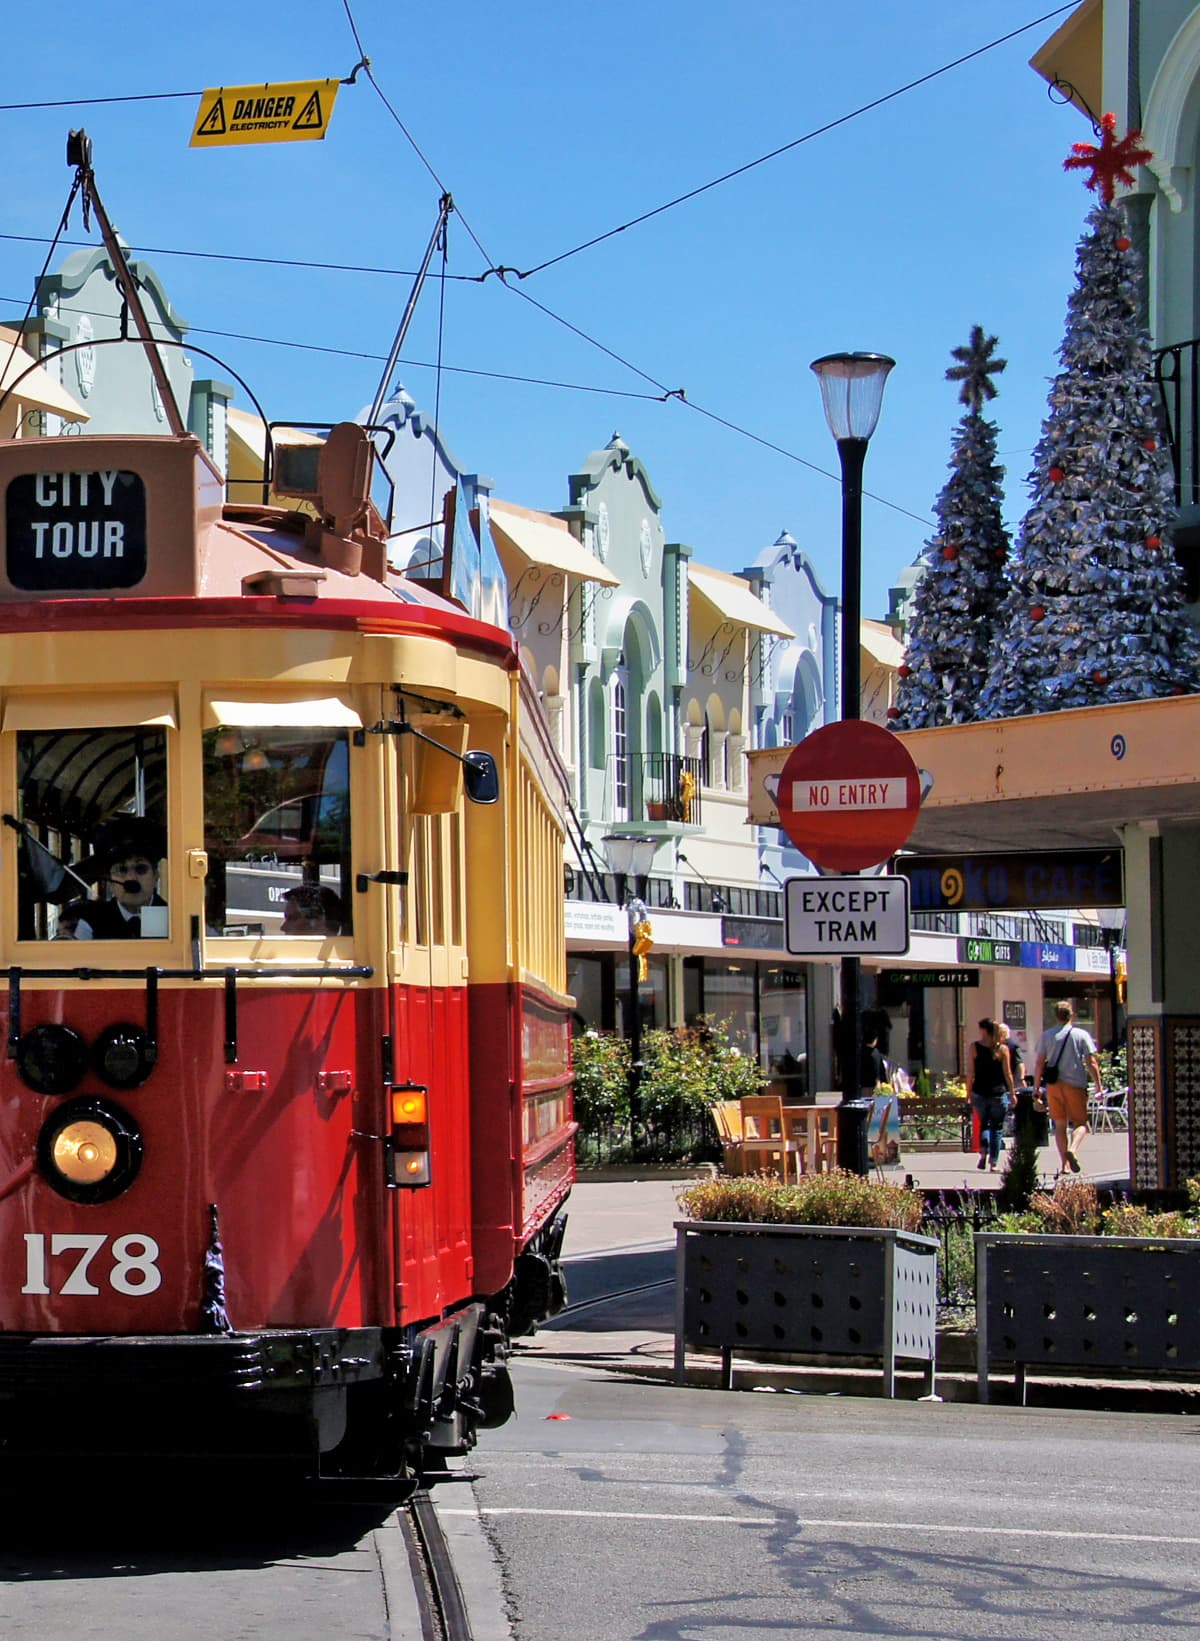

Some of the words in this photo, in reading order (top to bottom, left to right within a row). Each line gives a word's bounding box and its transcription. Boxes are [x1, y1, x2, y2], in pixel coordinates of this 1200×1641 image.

[232, 96, 296, 120] DANGER
[229, 120, 290, 131] ELECTRICITY
[35, 470, 119, 507] CITY
[31, 520, 125, 559] TOUR
[809, 785, 829, 806] NO
[839, 783, 889, 805] ENTRY
[803, 891, 890, 912] EXCEPT
[814, 920, 877, 942] TRAM
[995, 945, 1010, 960] GIFTS
[912, 974, 935, 983] KIWI
[938, 974, 969, 983] GIFTS
[21, 1233, 162, 1296] 178
